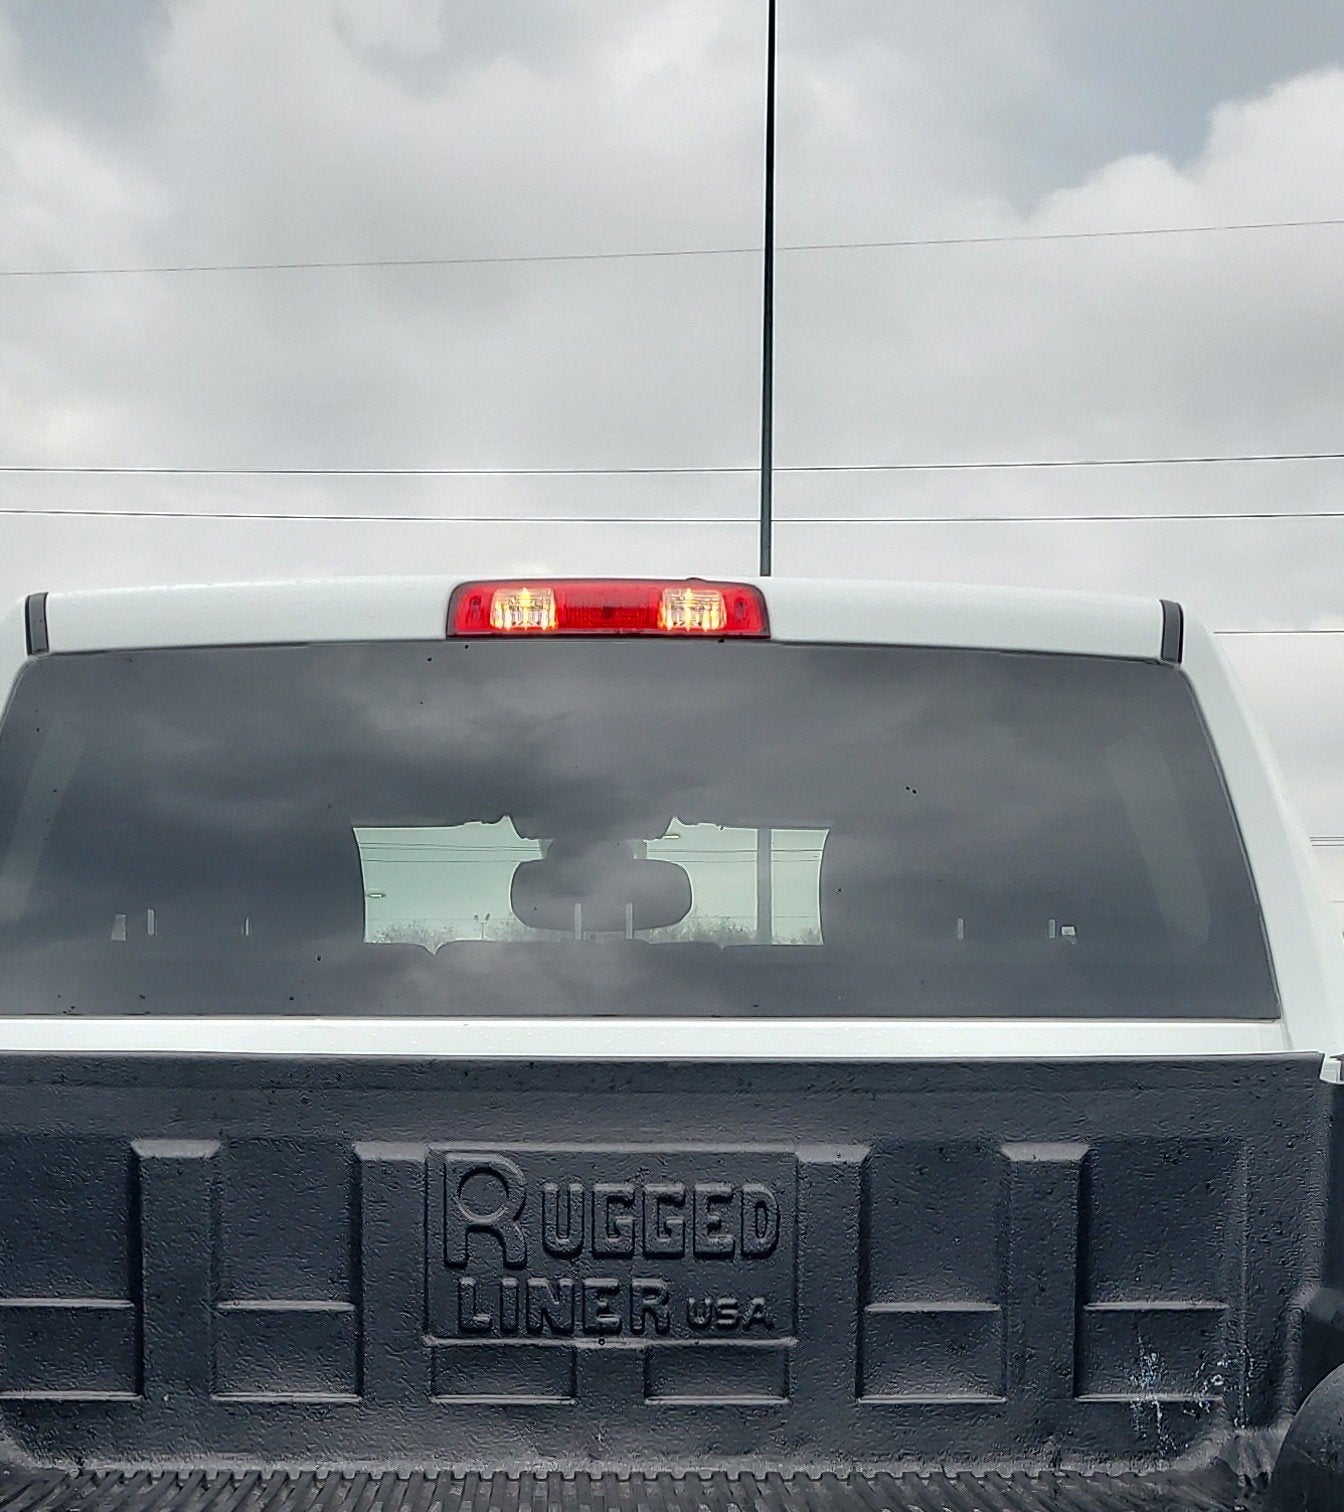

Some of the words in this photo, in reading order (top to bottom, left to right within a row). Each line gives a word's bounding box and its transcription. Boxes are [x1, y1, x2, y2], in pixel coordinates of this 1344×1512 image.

[443, 1152, 781, 1270] RUGGED
[457, 1277, 671, 1335] LINER
[685, 1296, 775, 1330] USA
